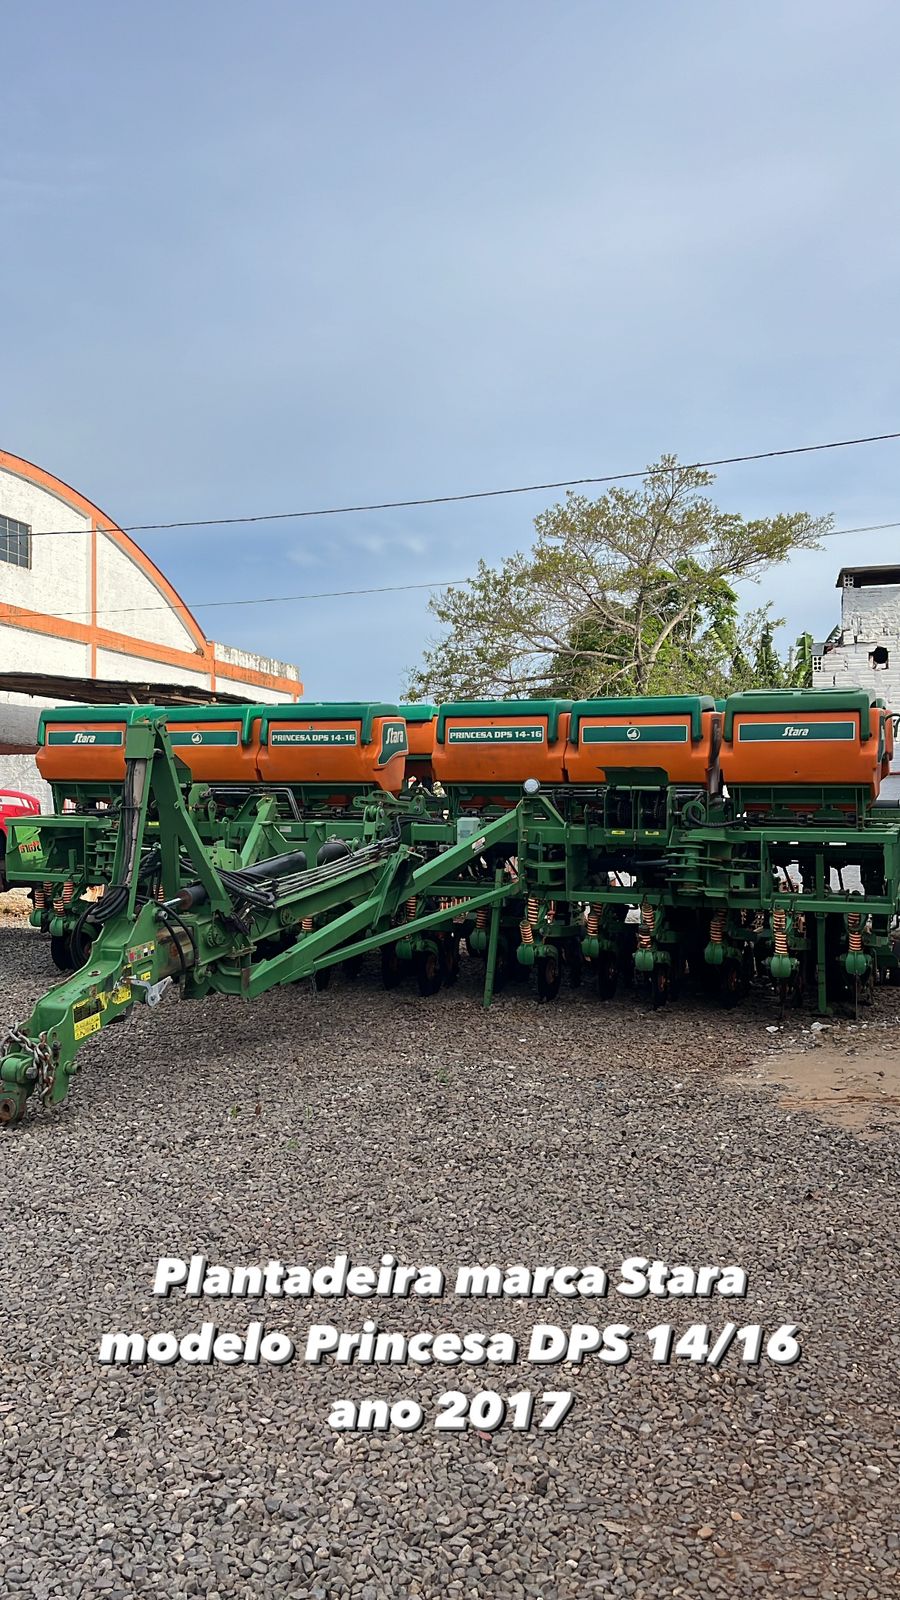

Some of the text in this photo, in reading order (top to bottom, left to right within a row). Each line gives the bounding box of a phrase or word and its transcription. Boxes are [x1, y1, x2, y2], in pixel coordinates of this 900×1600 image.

[385, 727, 404, 744] Stara
[449, 731, 493, 739] PRINCESA
[514, 730, 542, 738] 14-16
[782, 726, 809, 737] Stara
[72, 733, 96, 743] Stara
[272, 734, 311, 742] PRINCESA
[312, 734, 329, 742] DPS
